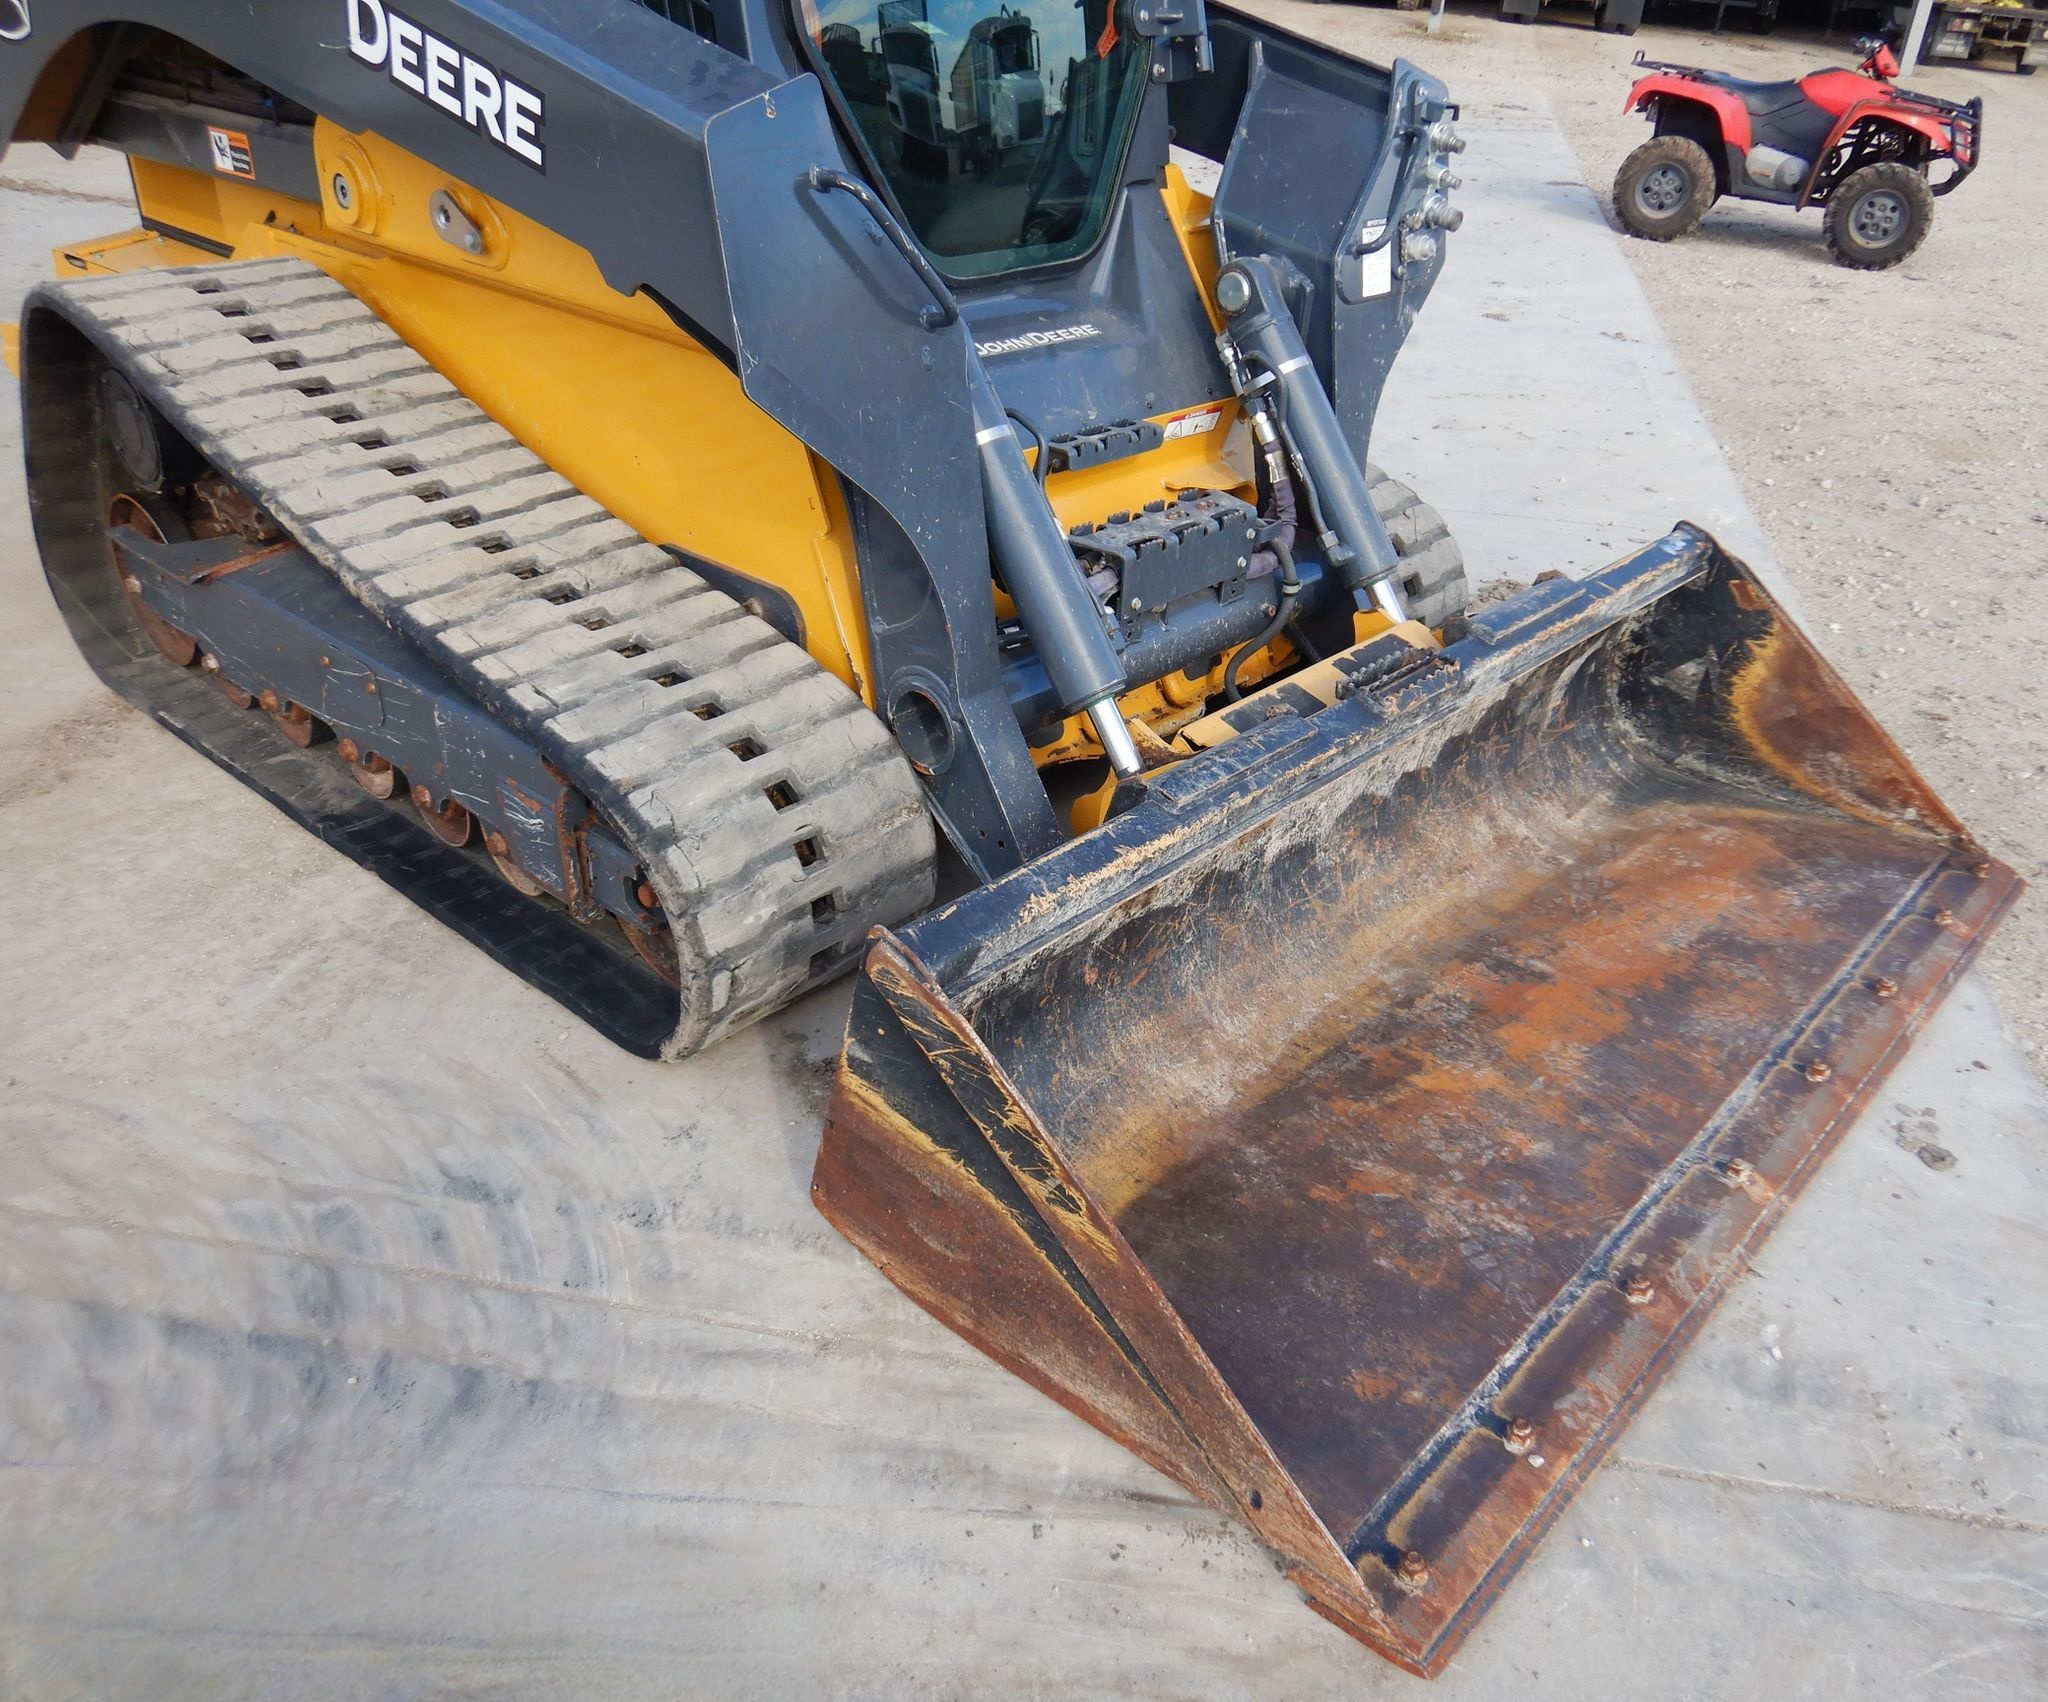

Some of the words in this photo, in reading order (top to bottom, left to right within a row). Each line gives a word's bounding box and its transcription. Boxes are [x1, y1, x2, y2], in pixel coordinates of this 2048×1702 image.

[348, 0, 542, 166] DEERE
[974, 336, 1033, 356] JOHN
[1026, 324, 1101, 344] DEERE
